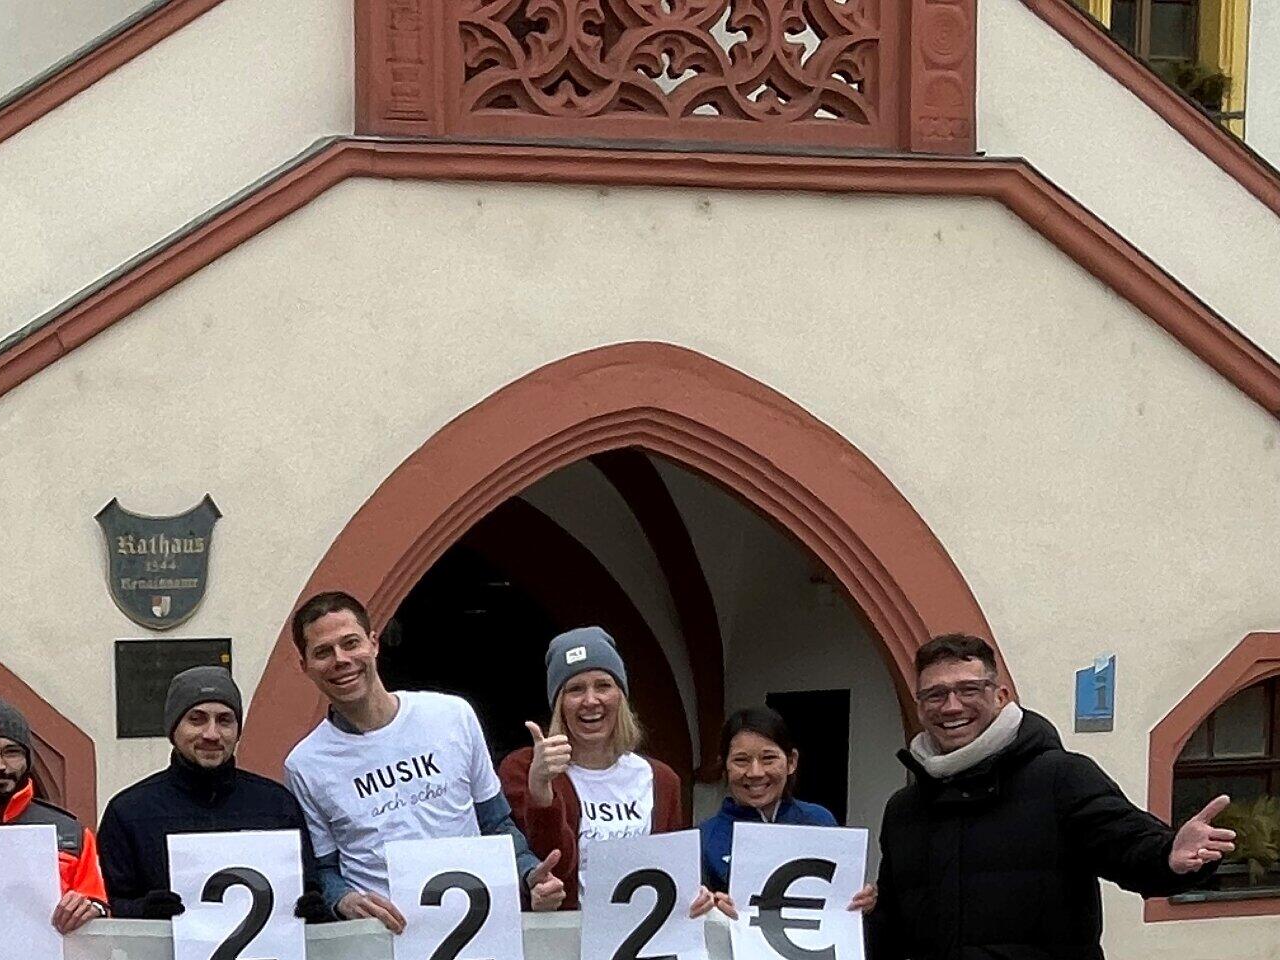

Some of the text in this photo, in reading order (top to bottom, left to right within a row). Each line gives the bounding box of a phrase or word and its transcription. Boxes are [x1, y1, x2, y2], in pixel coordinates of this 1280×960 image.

[117, 533, 205, 557] Rathaus
[353, 752, 441, 799] MUSIK
[583, 800, 642, 821] USIK
